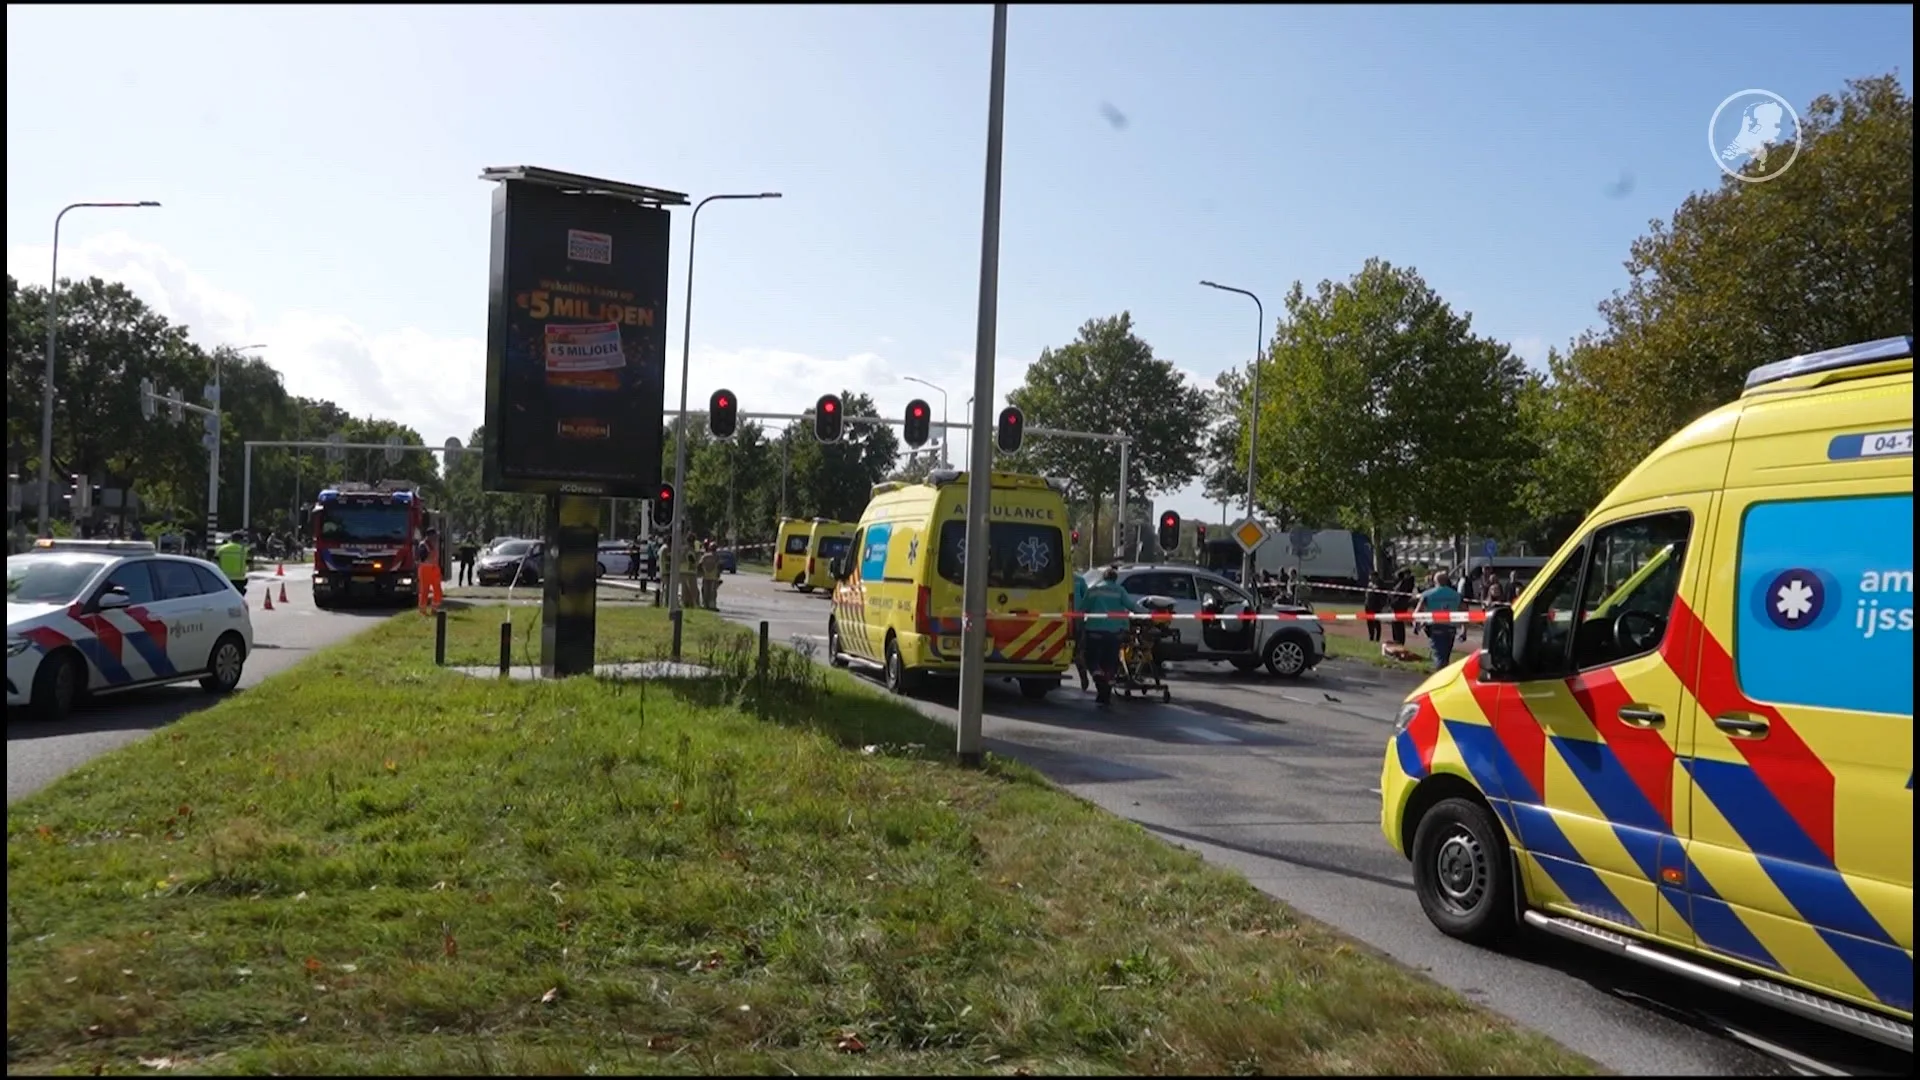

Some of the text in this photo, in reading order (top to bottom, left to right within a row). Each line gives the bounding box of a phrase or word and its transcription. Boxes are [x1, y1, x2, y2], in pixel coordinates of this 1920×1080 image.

[553, 297, 654, 327] MILJOEN
[567, 343, 618, 356] MILJOEN
[953, 503, 1055, 520] AULANCE
